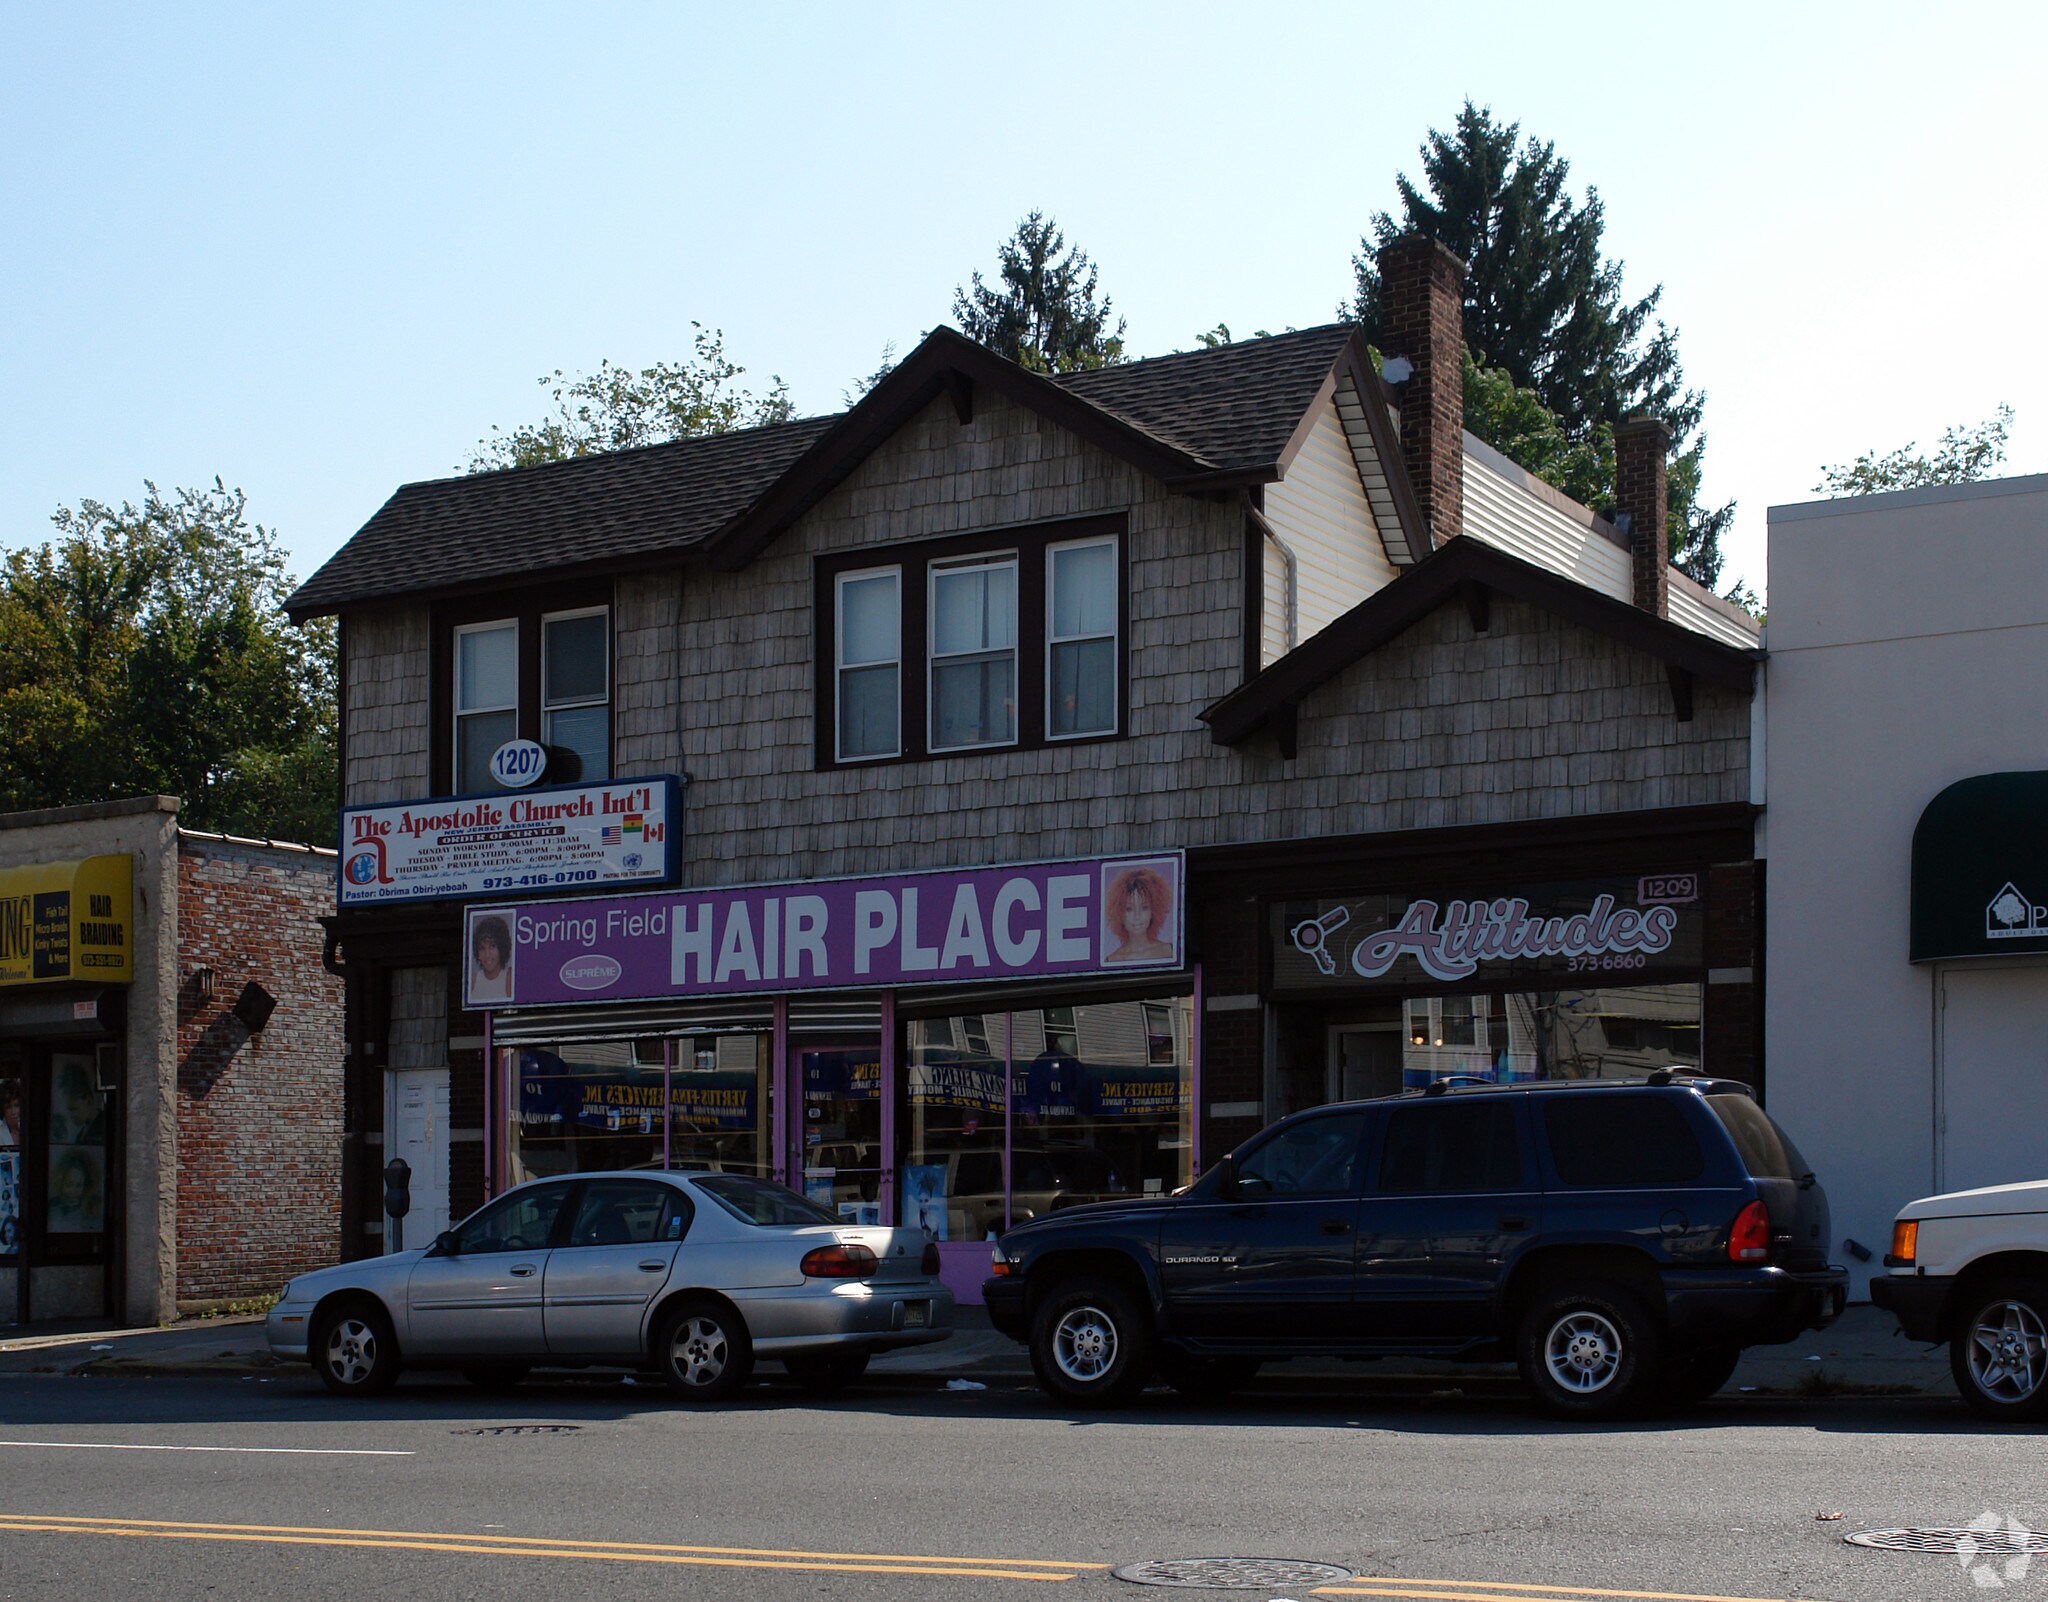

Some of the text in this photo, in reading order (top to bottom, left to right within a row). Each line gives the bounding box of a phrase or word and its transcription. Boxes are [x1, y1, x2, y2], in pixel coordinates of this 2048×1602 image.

[497, 748, 539, 775] 1207
[351, 788, 651, 838] The Apostolic Church Int'l
[442, 834, 486, 844] ORDER
[509, 828, 558, 838] SERVICE
[467, 825, 501, 833] JERSEY
[504, 821, 553, 830] ASSEMBLY
[408, 855, 445, 865] TUESDAY
[453, 852, 478, 861] BIBLE
[418, 845, 452, 855] SUNDAY
[395, 863, 439, 874] THURSDAY
[447, 860, 480, 869] PRAYER
[483, 870, 597, 889] 973-416-0700
[1648, 878, 1692, 897] 1209
[346, 882, 468, 899] Pastor: Obrima Obiri-yeboah
[90, 894, 112, 918] HAIR
[80, 922, 124, 946] BRAIDING
[516, 874, 1091, 985] Spring Field HAIR PLACE
[1352, 893, 1678, 981] Attitudes
[1567, 954, 1646, 972] 373-6860
